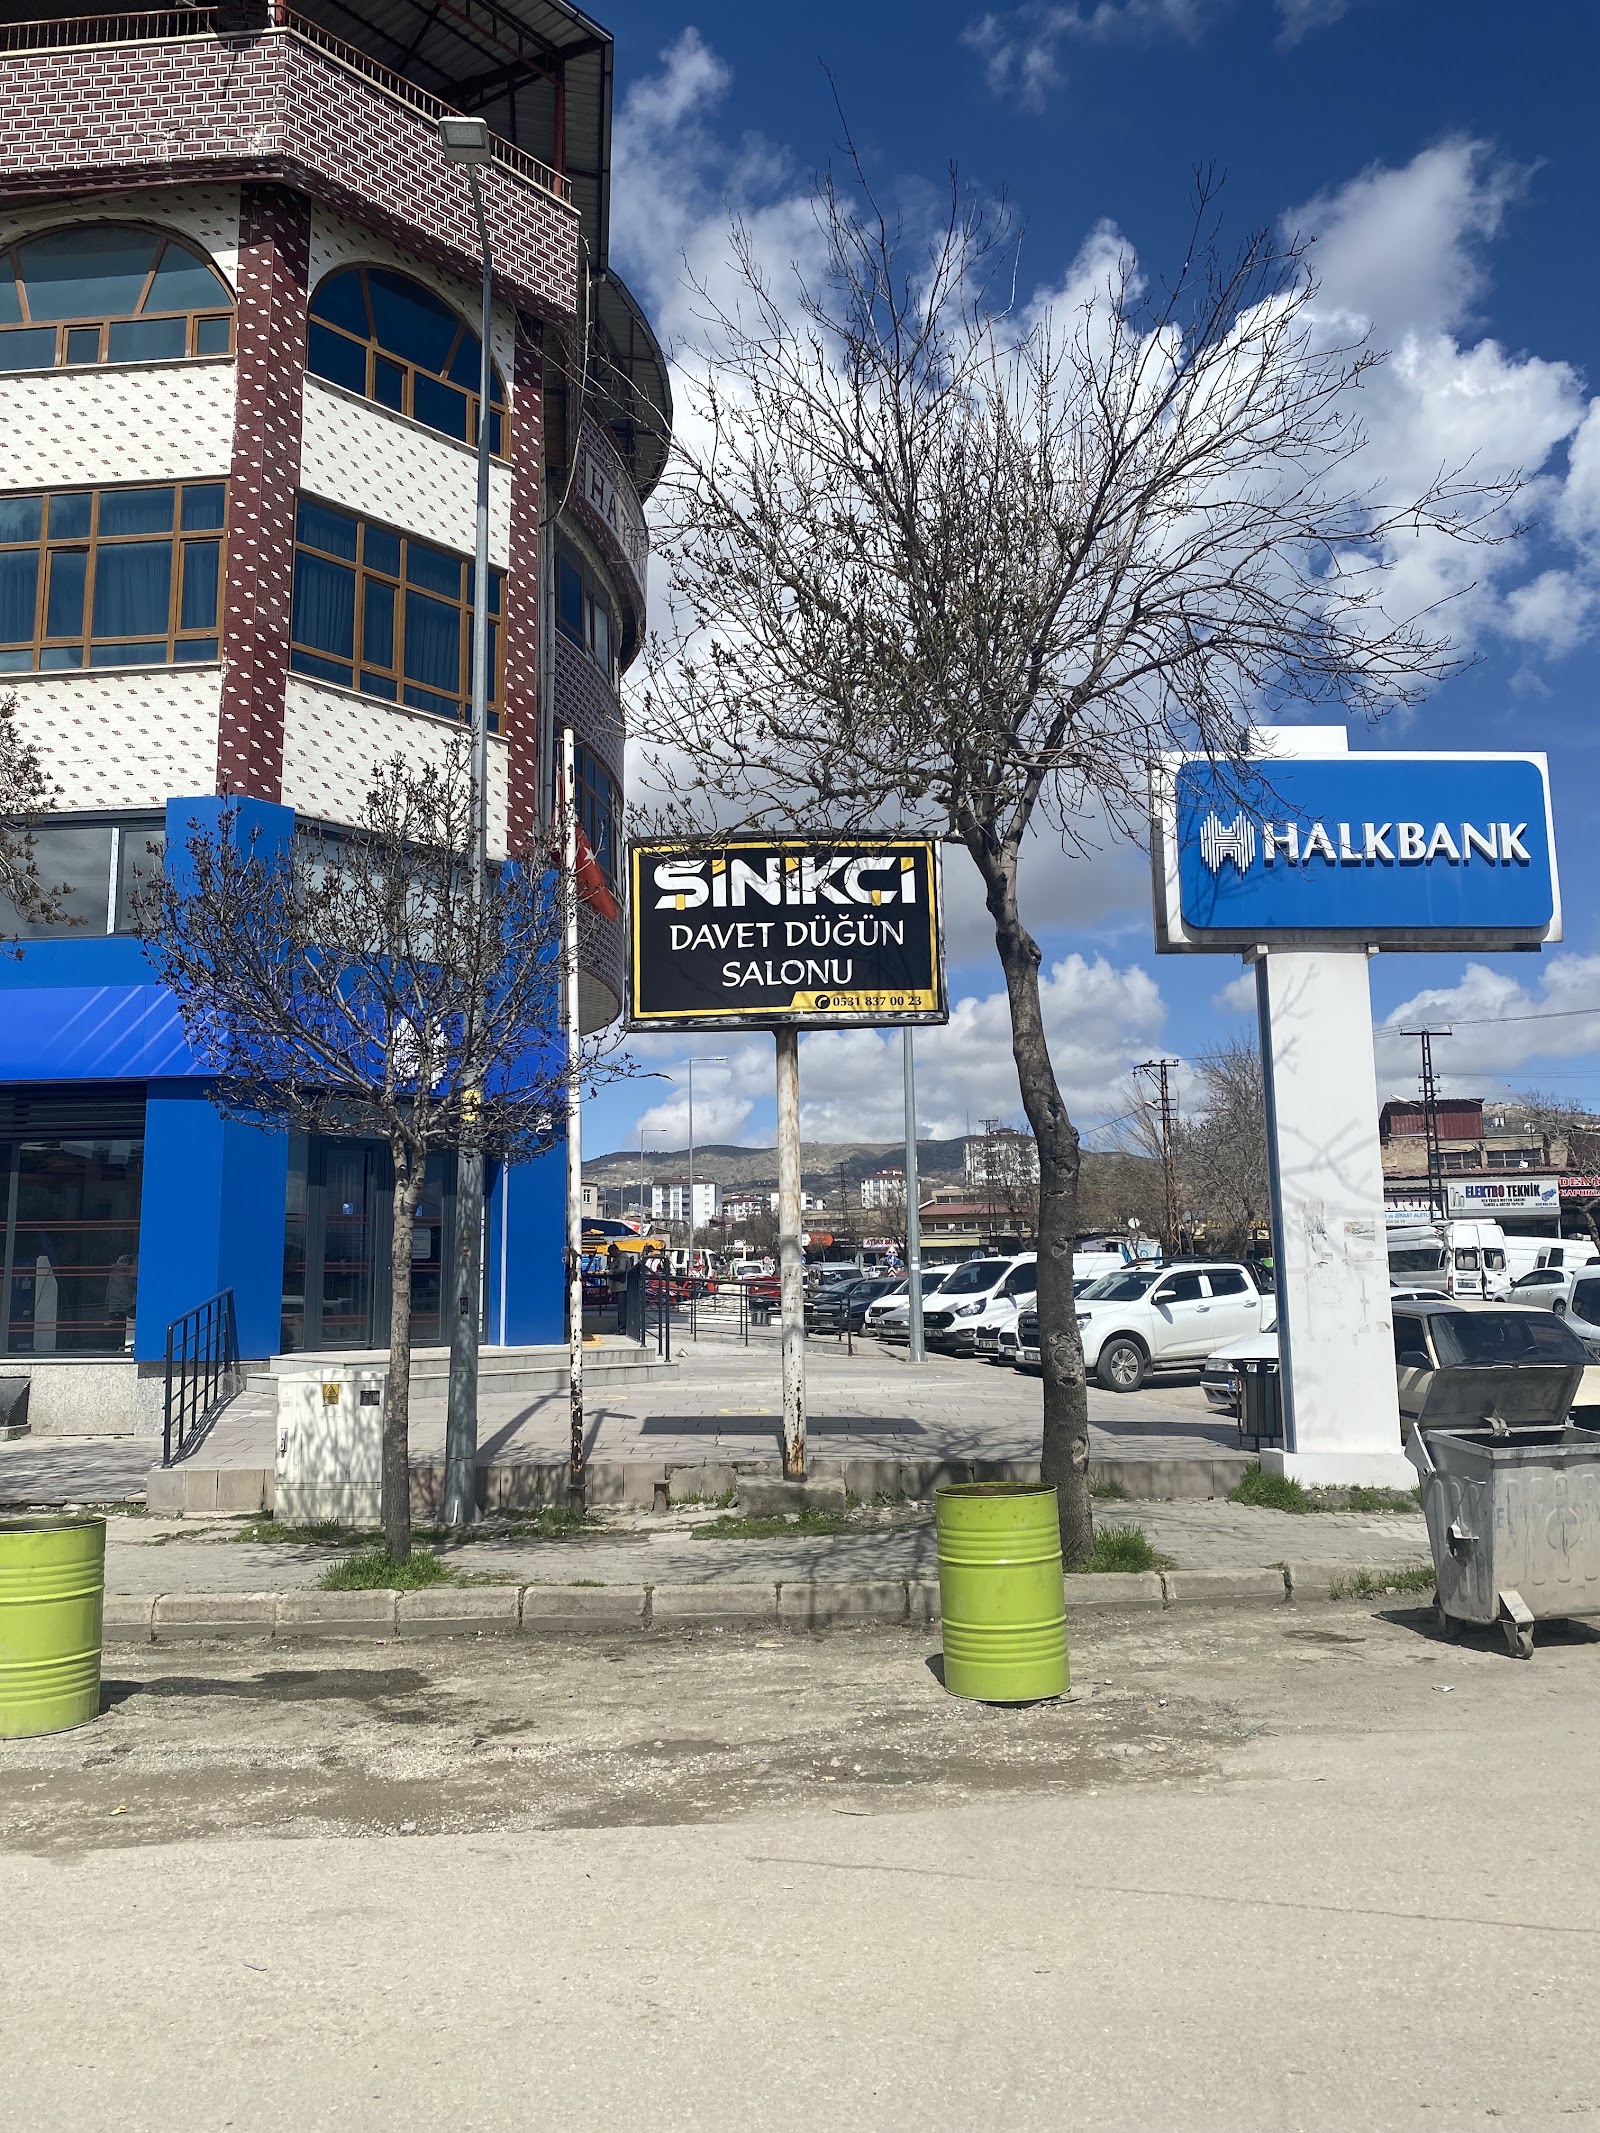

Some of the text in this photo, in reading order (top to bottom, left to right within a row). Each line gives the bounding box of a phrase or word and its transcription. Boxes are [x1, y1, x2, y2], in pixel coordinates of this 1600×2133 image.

[1263, 822, 1531, 862] HALKBANK
[669, 914, 904, 950] DAVET DÜĞÜN
[722, 959, 852, 988] SALONU
[833, 996, 922, 1006] 0531 837 00 23
[1465, 1183, 1541, 1198] ELEKTRO TEKNİK
